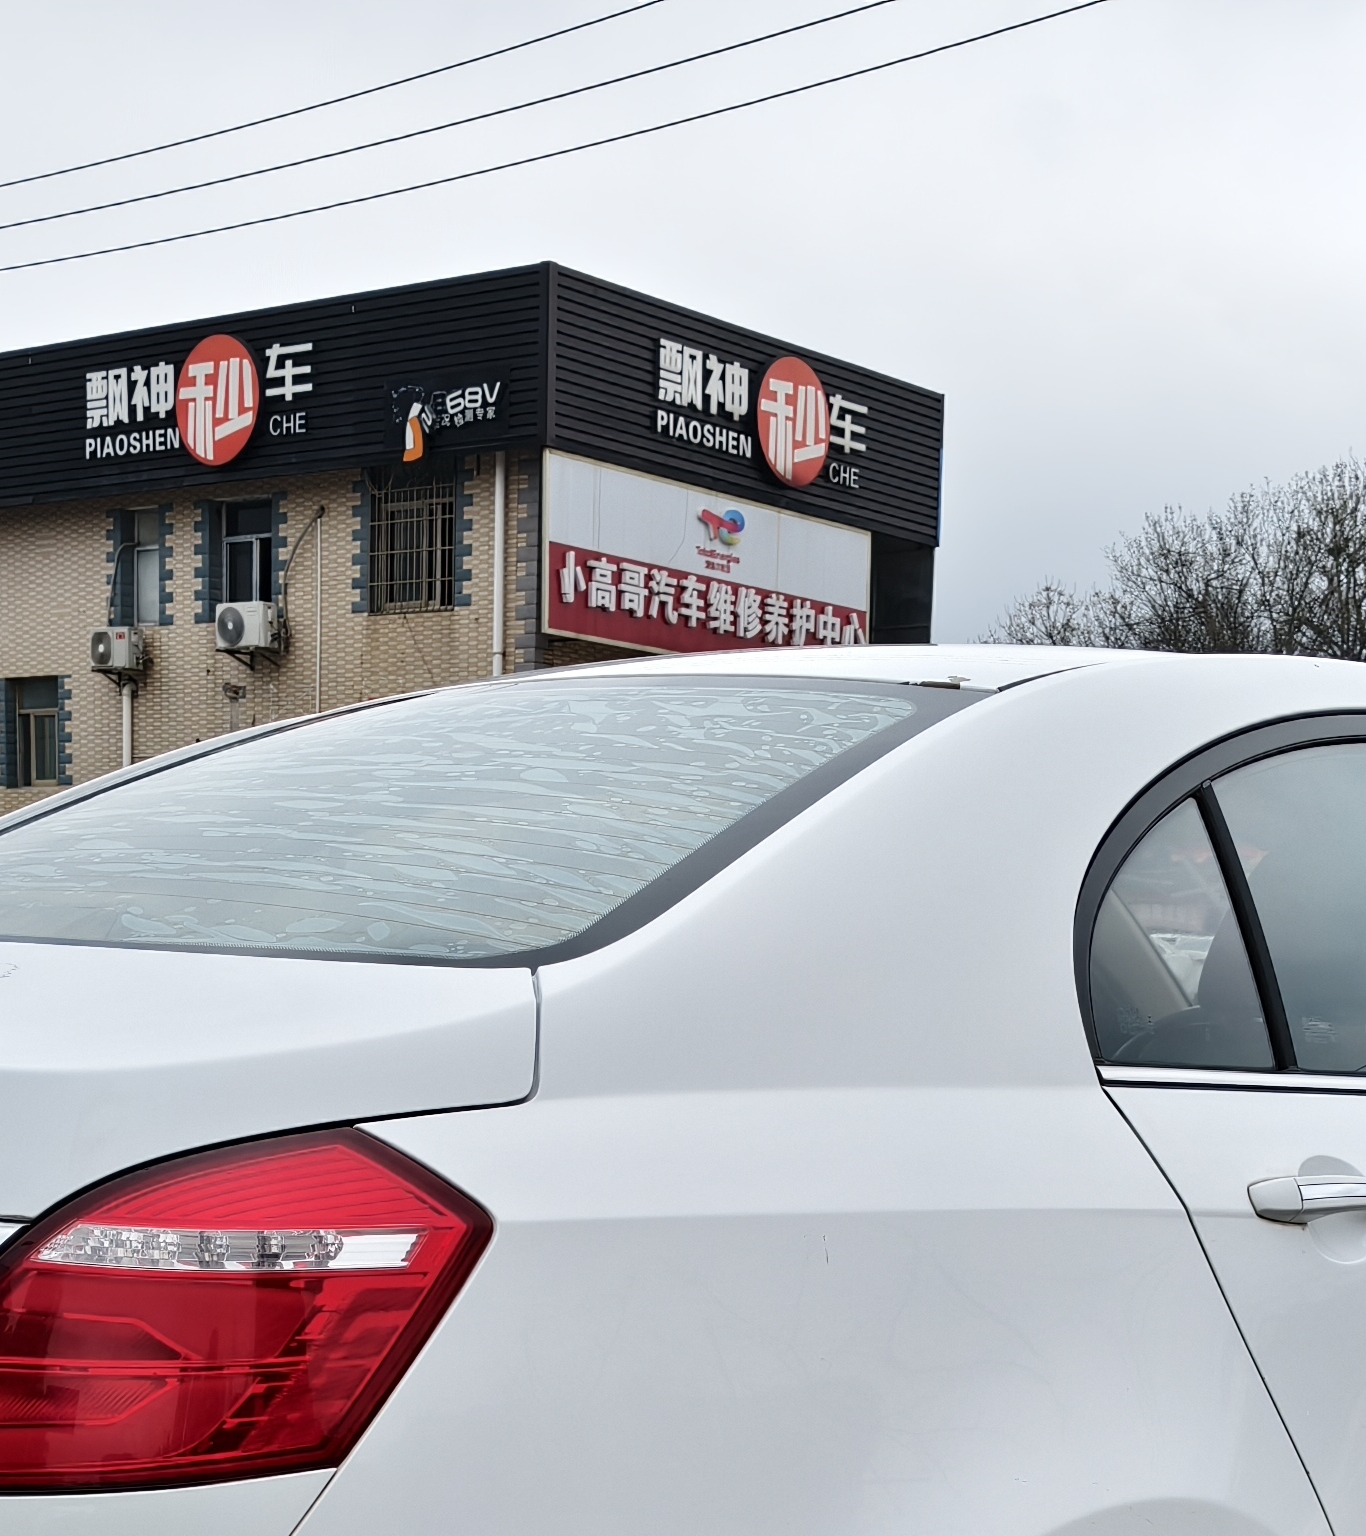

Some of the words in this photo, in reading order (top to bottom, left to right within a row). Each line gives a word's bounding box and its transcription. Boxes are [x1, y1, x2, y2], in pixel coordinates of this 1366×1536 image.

[85, 427, 180, 459] PIAOSHEN
[269, 412, 306, 437] CHE
[86, 343, 313, 460] 飘神秒车
[657, 410, 752, 459] PIAOSHEN
[829, 462, 860, 489] CHE
[659, 338, 868, 480] 飘神秒车
